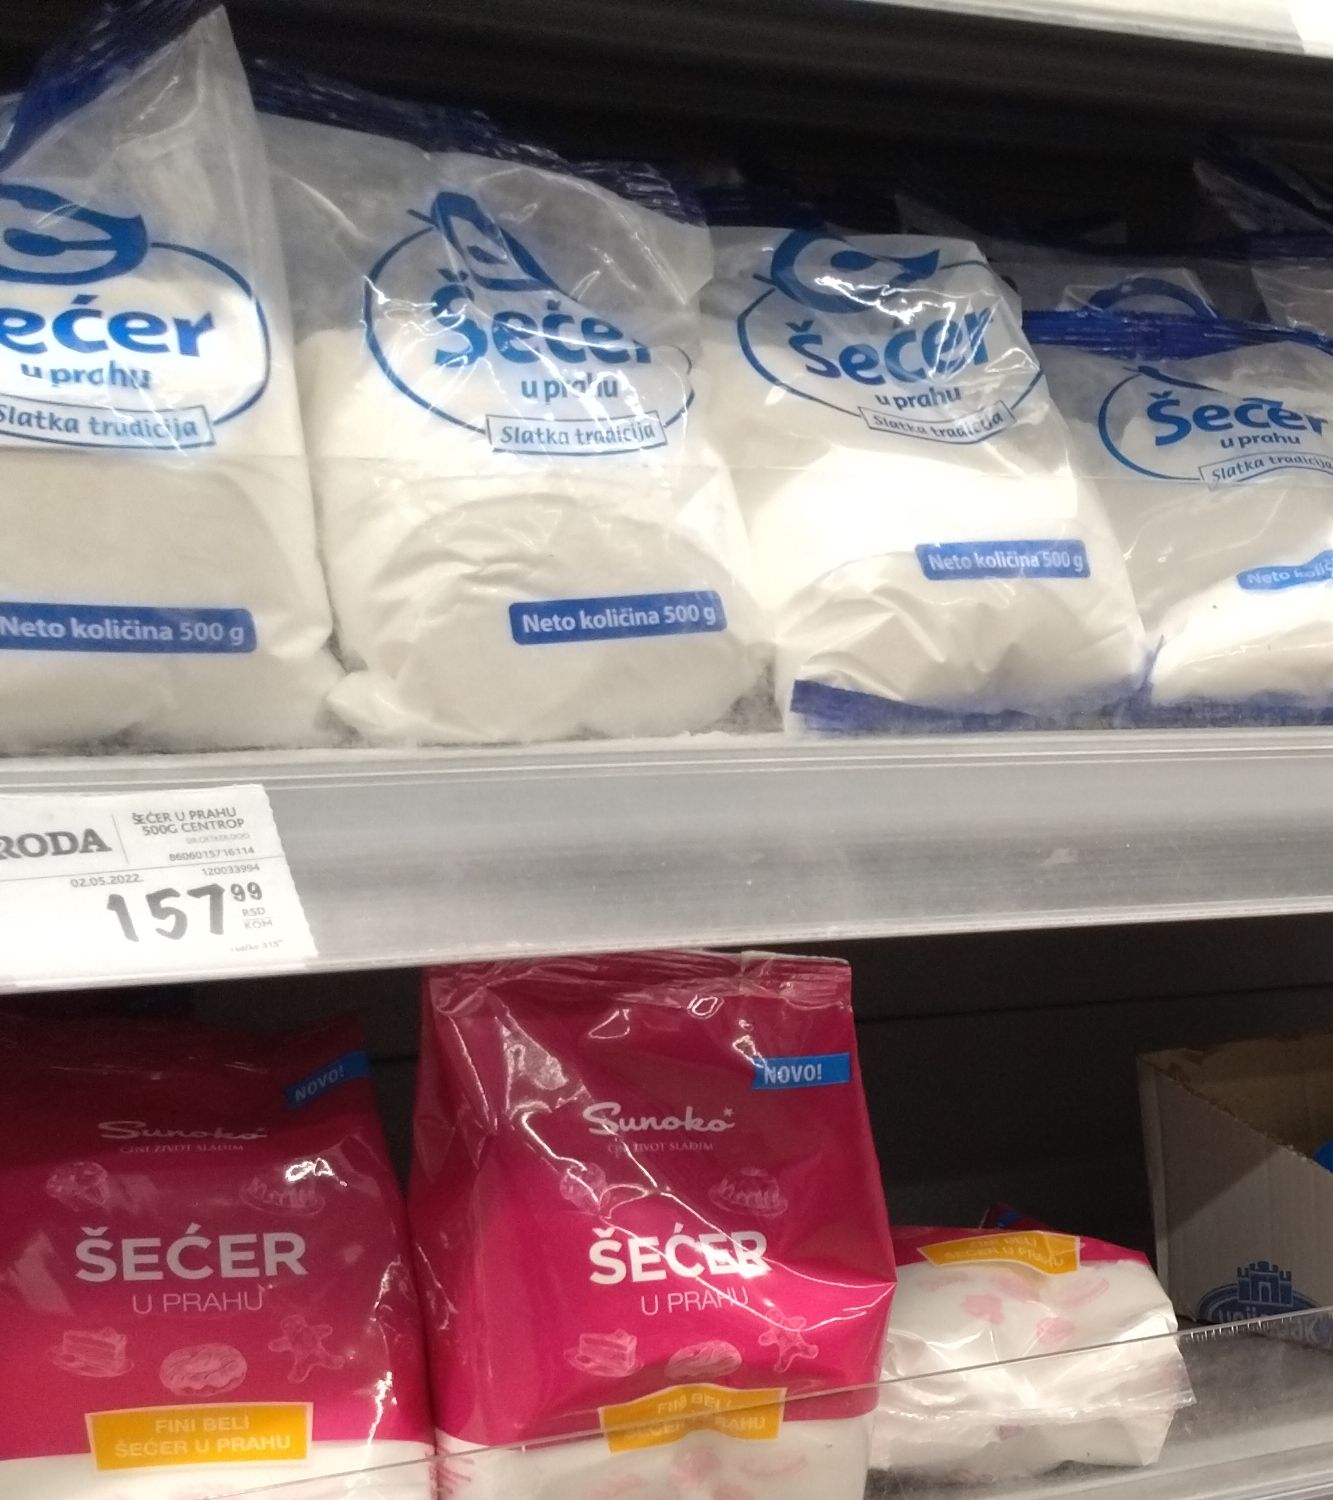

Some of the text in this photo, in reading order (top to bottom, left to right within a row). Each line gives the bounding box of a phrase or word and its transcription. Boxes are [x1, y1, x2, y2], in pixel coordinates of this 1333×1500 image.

[0, 297, 214, 358] ećer
[896, 386, 961, 412] prahu
[500, 425, 570, 445] Slatka
[1241, 432, 1300, 452] prahu
[929, 550, 1038, 572] Neto količina
[522, 604, 716, 632] Neto količina 500 g
[71, 616, 173, 641] količina
[179, 622, 219, 642] 500
[226, 626, 244, 647] g
[190, 807, 236, 819] PRAHU
[142, 818, 244, 836] 500G CENTROP
[97, 1120, 264, 1141] Sunoko
[582, 1102, 730, 1136] Sunoko
[76, 1222, 308, 1283] ŠEĆER
[589, 1222, 769, 1285] ŠEĆER
[133, 1289, 263, 1315] U PRAHU
[642, 1288, 748, 1315] U PRAHU
[194, 1434, 291, 1455] U PRAHU
